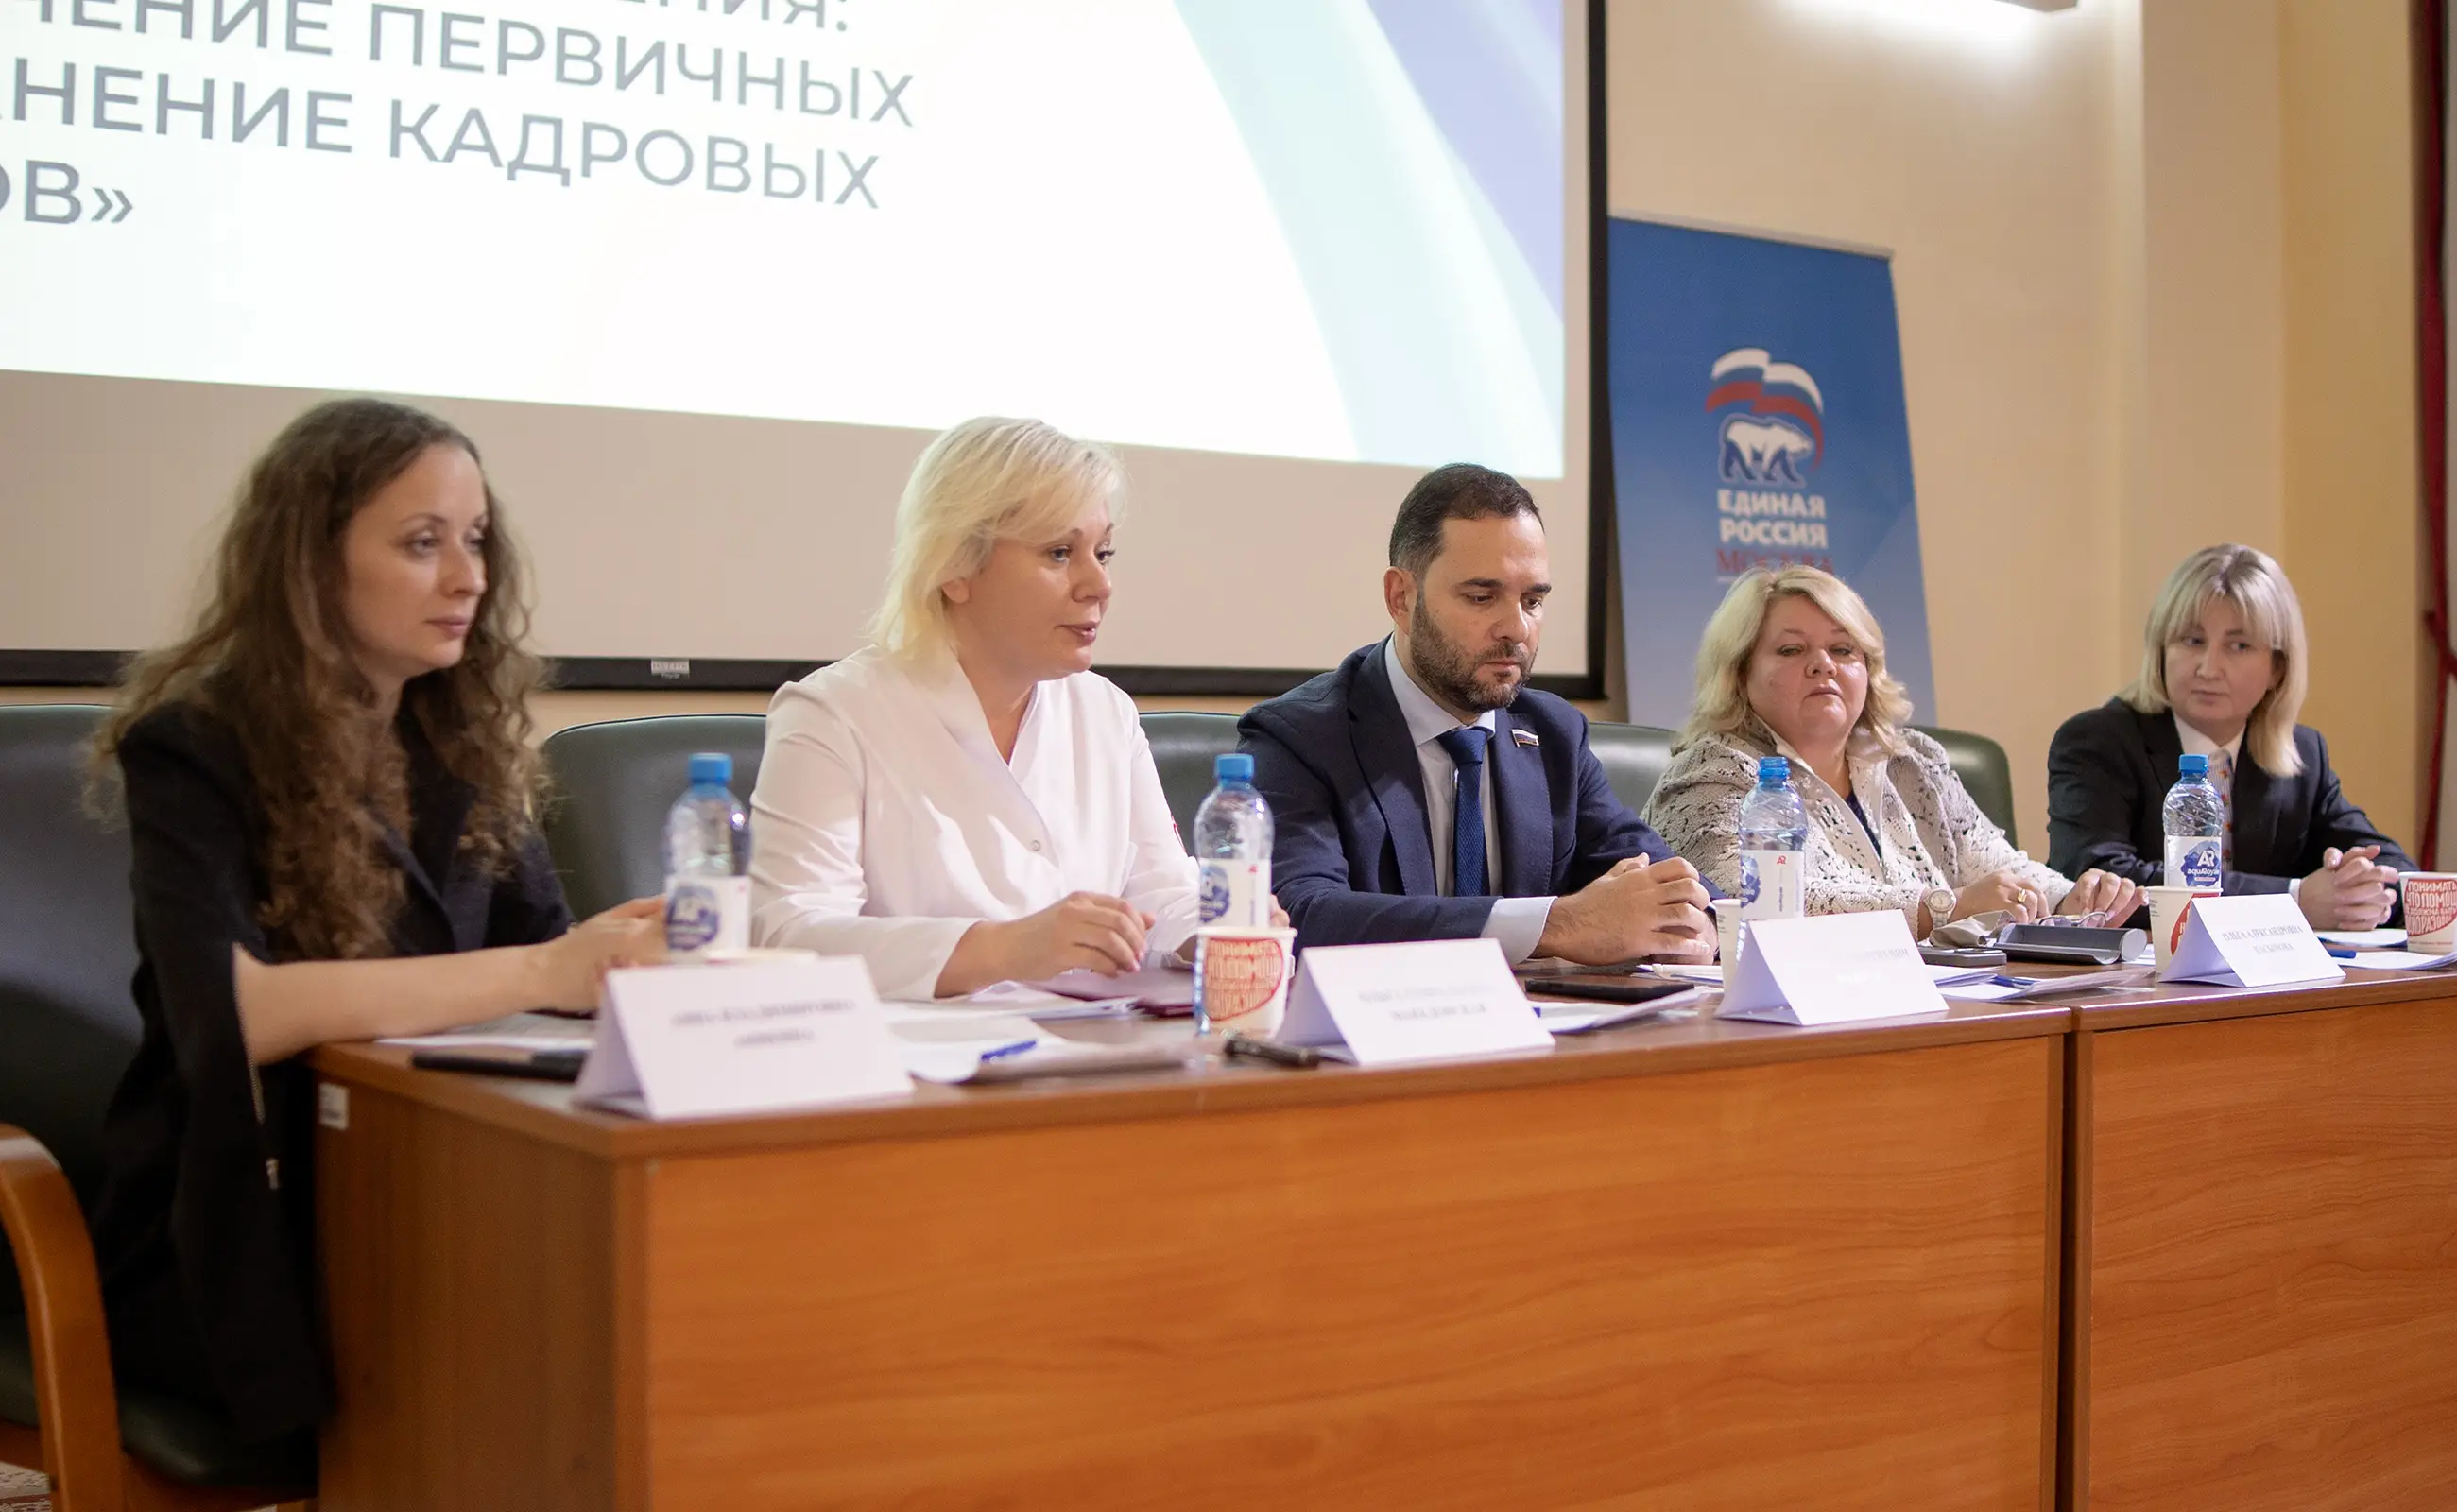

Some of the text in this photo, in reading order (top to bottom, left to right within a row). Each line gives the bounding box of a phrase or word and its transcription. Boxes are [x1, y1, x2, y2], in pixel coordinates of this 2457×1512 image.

[369, 3, 914, 127] ПЕРВИЧНЫХ
[0, 57, 880, 209] НЕНИЕ КАДРОВЫХ
[0, 159, 133, 224] В»
[1717, 489, 1827, 519] ЕДИНАЯ
[1719, 517, 1829, 549] РОССИЯ
